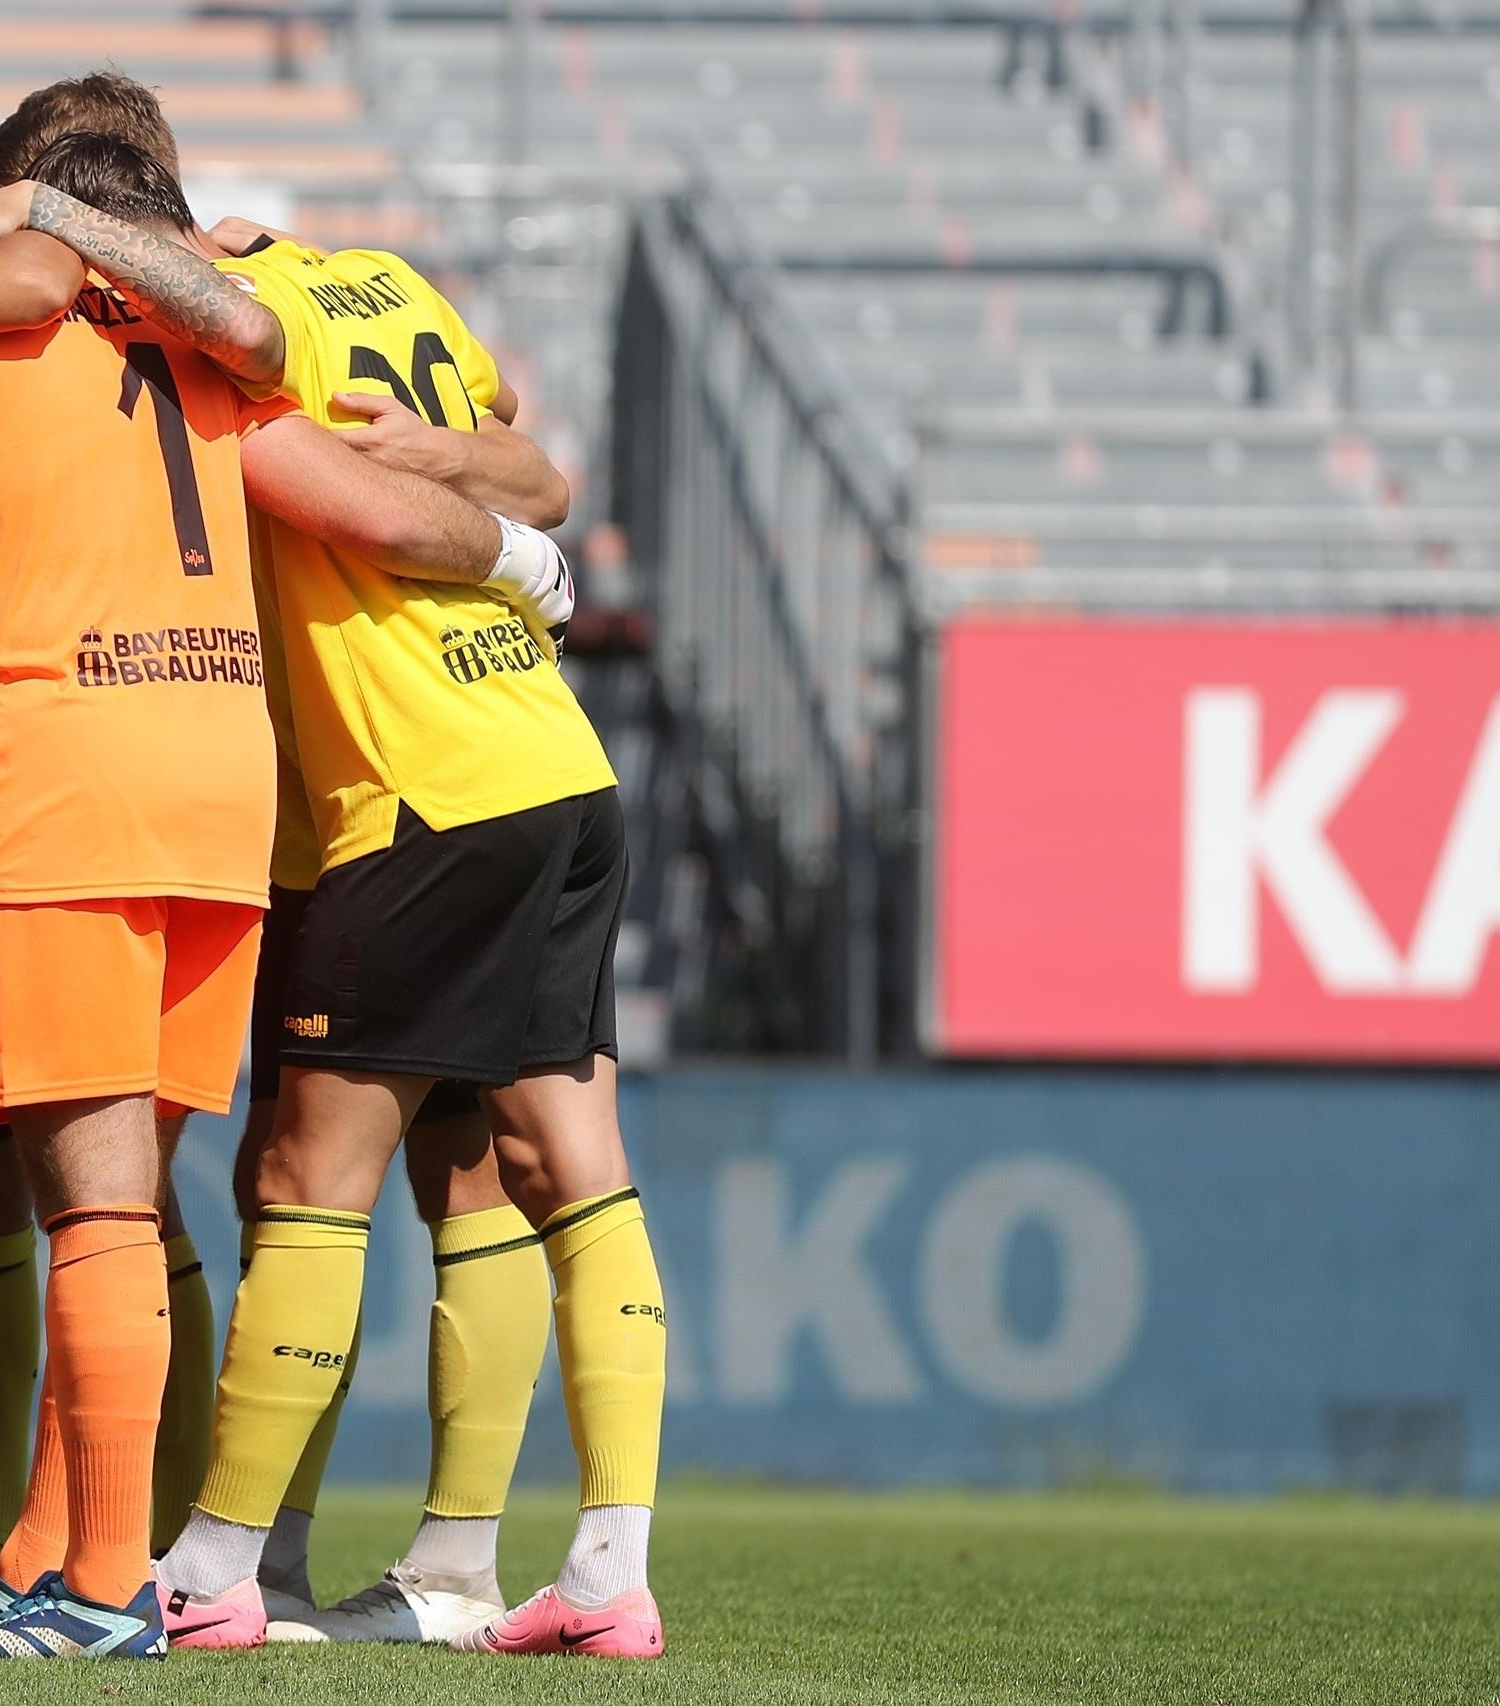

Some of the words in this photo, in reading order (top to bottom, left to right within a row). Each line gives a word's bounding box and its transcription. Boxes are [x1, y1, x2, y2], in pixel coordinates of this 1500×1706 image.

[119, 341, 213, 577] 1
[113, 628, 260, 657] BAYREUTHER
[118, 655, 263, 687] BRAUHAUS
[284, 1013, 328, 1034] capelli
